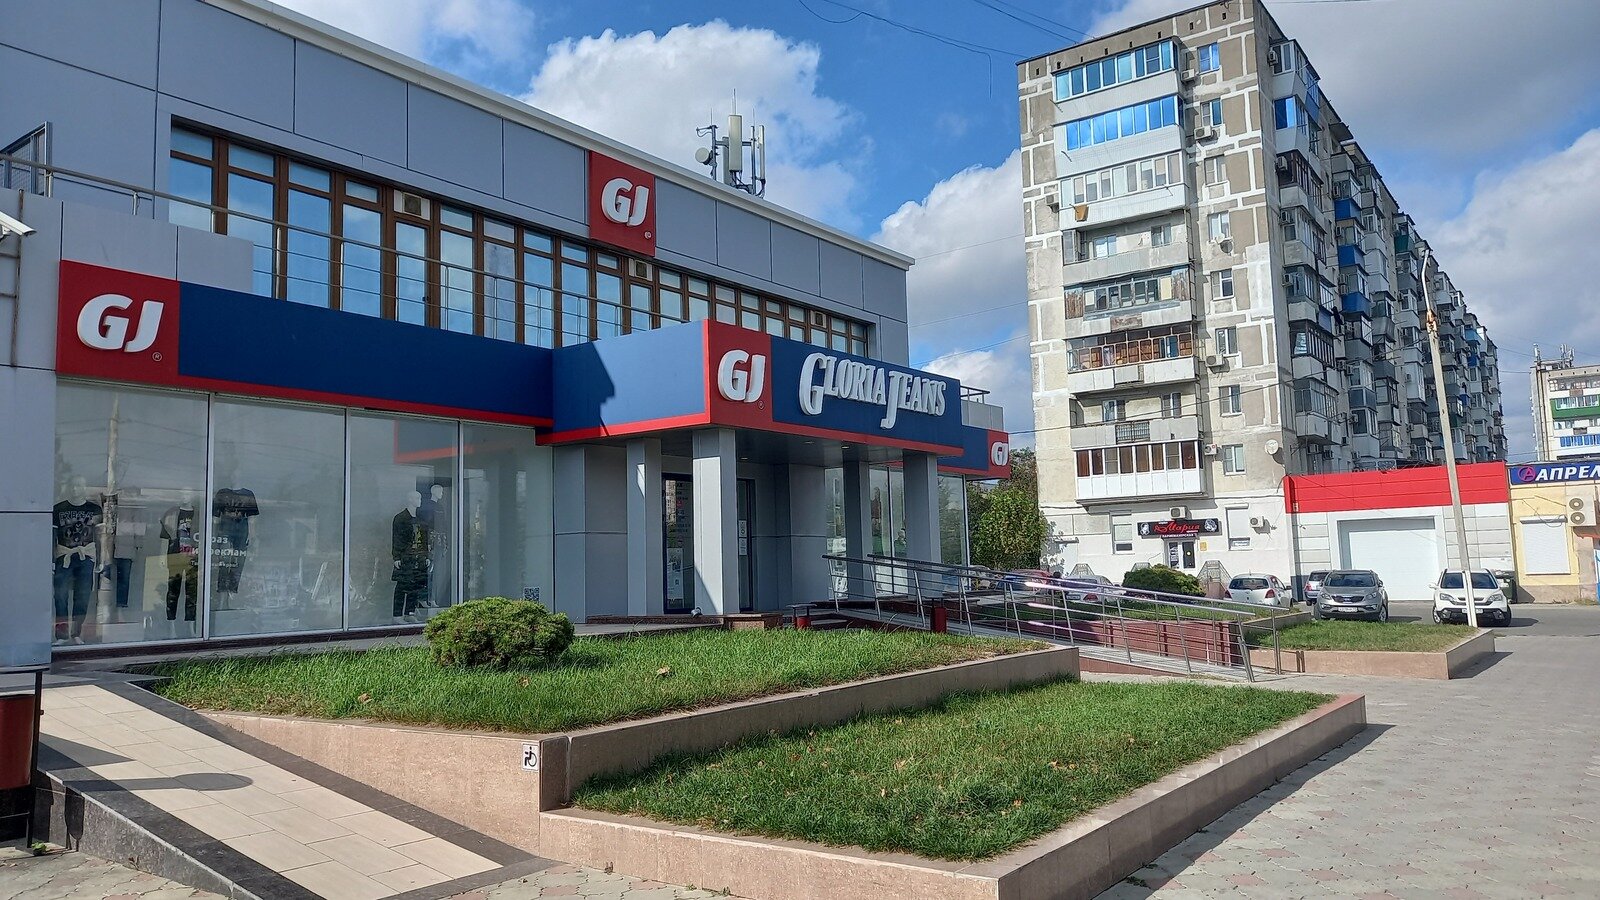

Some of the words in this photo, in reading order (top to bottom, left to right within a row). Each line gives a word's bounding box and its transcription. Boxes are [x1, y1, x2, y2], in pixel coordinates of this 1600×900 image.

[601, 177, 650, 227] GJ
[76, 293, 165, 353] GJ
[717, 349, 766, 403] GJ
[798, 352, 887, 416] GLORIA
[880, 370, 947, 429] JEANS
